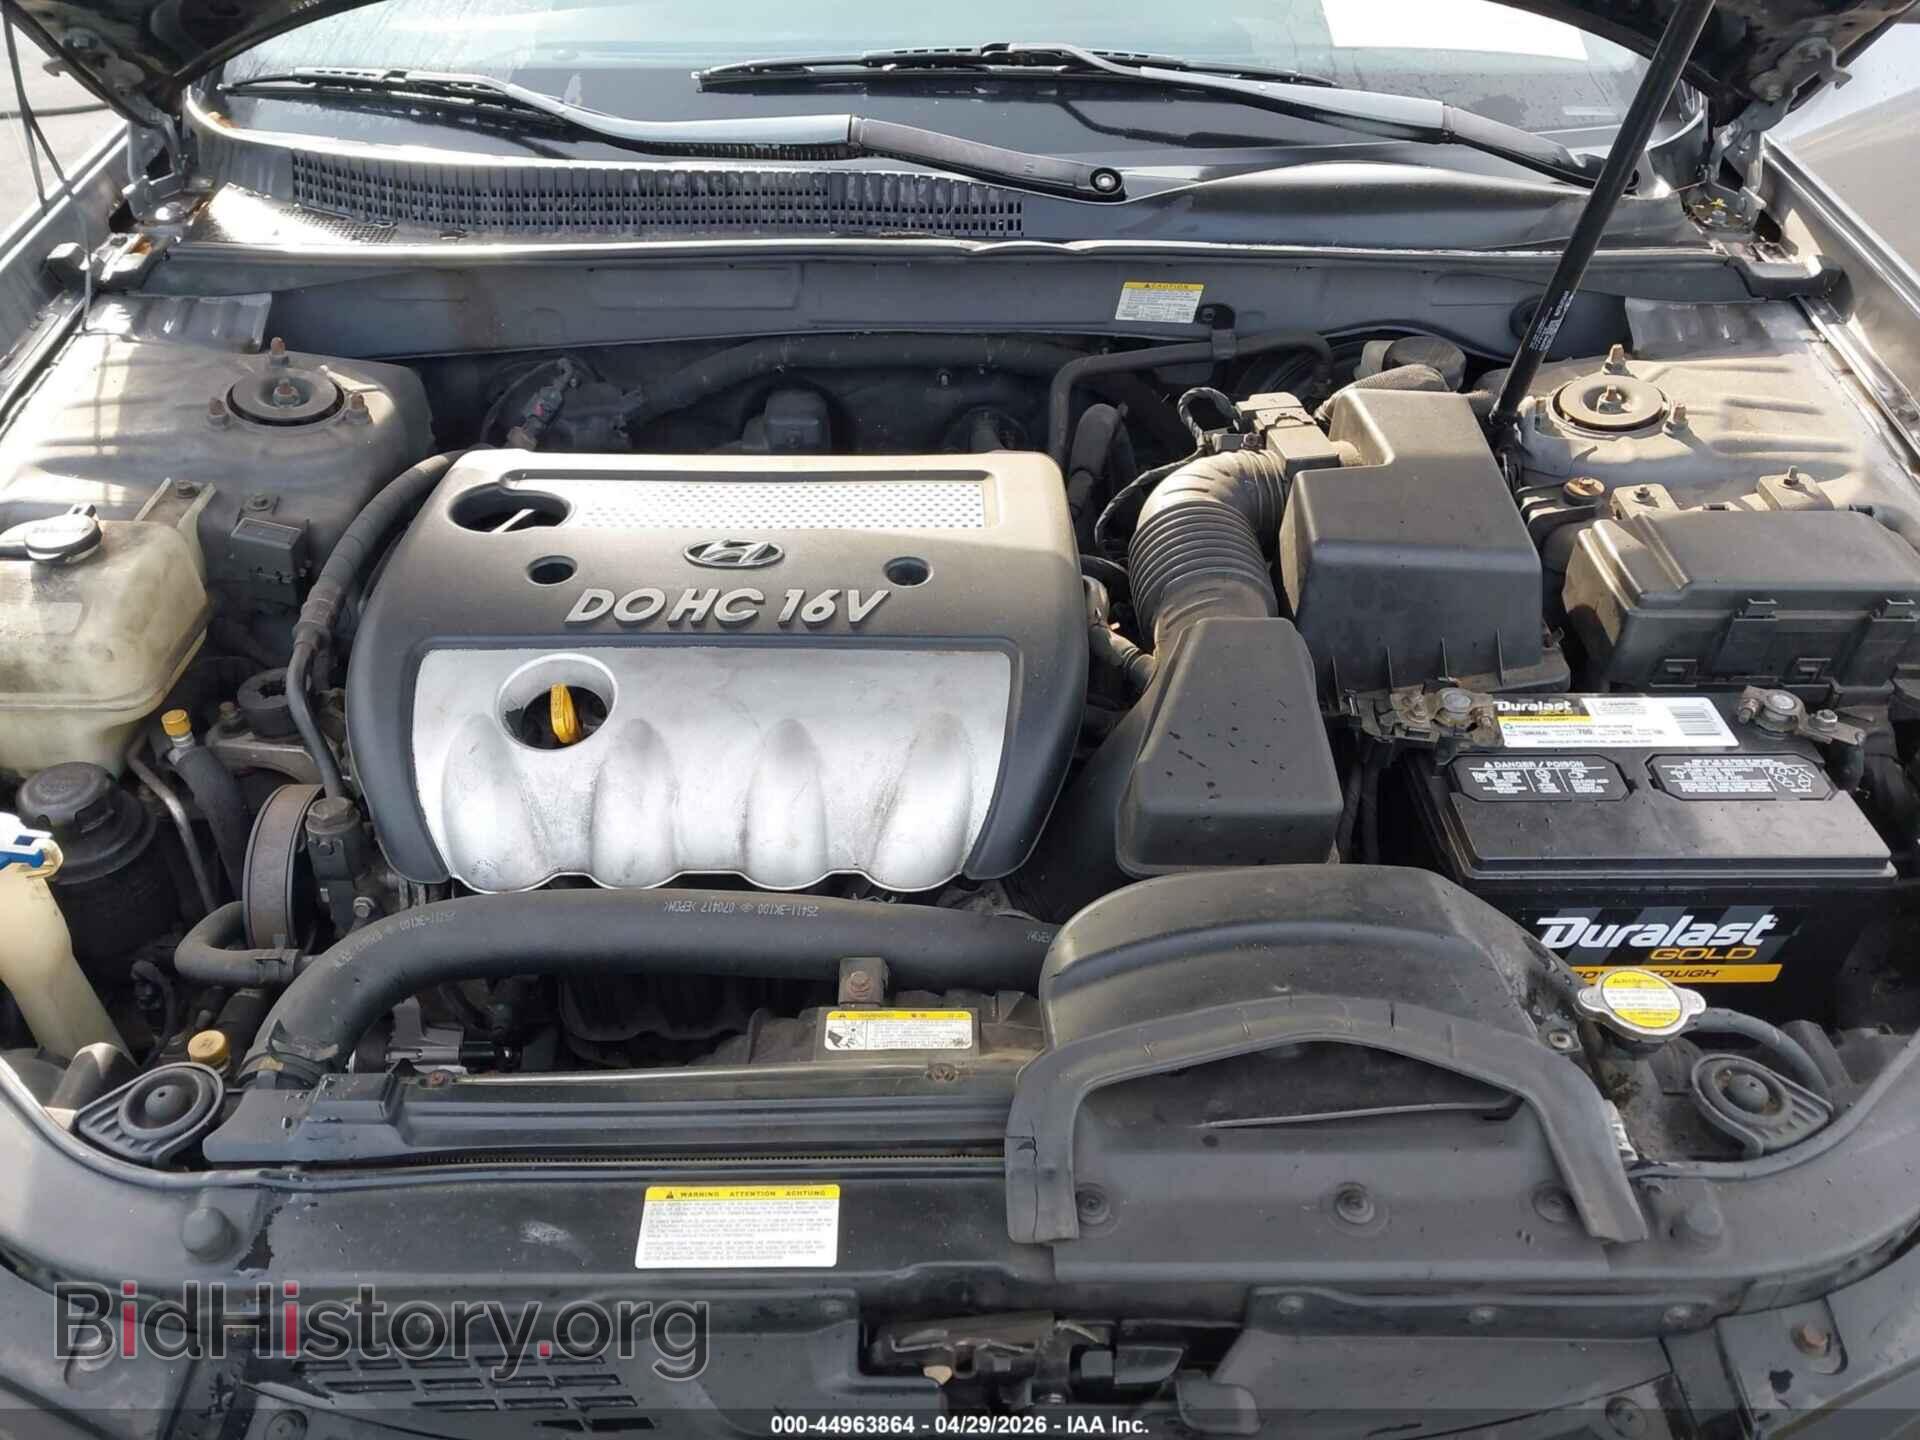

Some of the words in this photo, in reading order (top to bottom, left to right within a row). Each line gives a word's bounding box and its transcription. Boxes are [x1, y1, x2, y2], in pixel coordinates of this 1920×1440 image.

[564, 587, 765, 627] DOHC
[776, 589, 891, 627] 16V
[1493, 700, 1572, 712] Duralast
[1547, 760, 1585, 768] POISON
[1537, 914, 1776, 948] Duralast
[1650, 948, 1757, 960] GOLD
